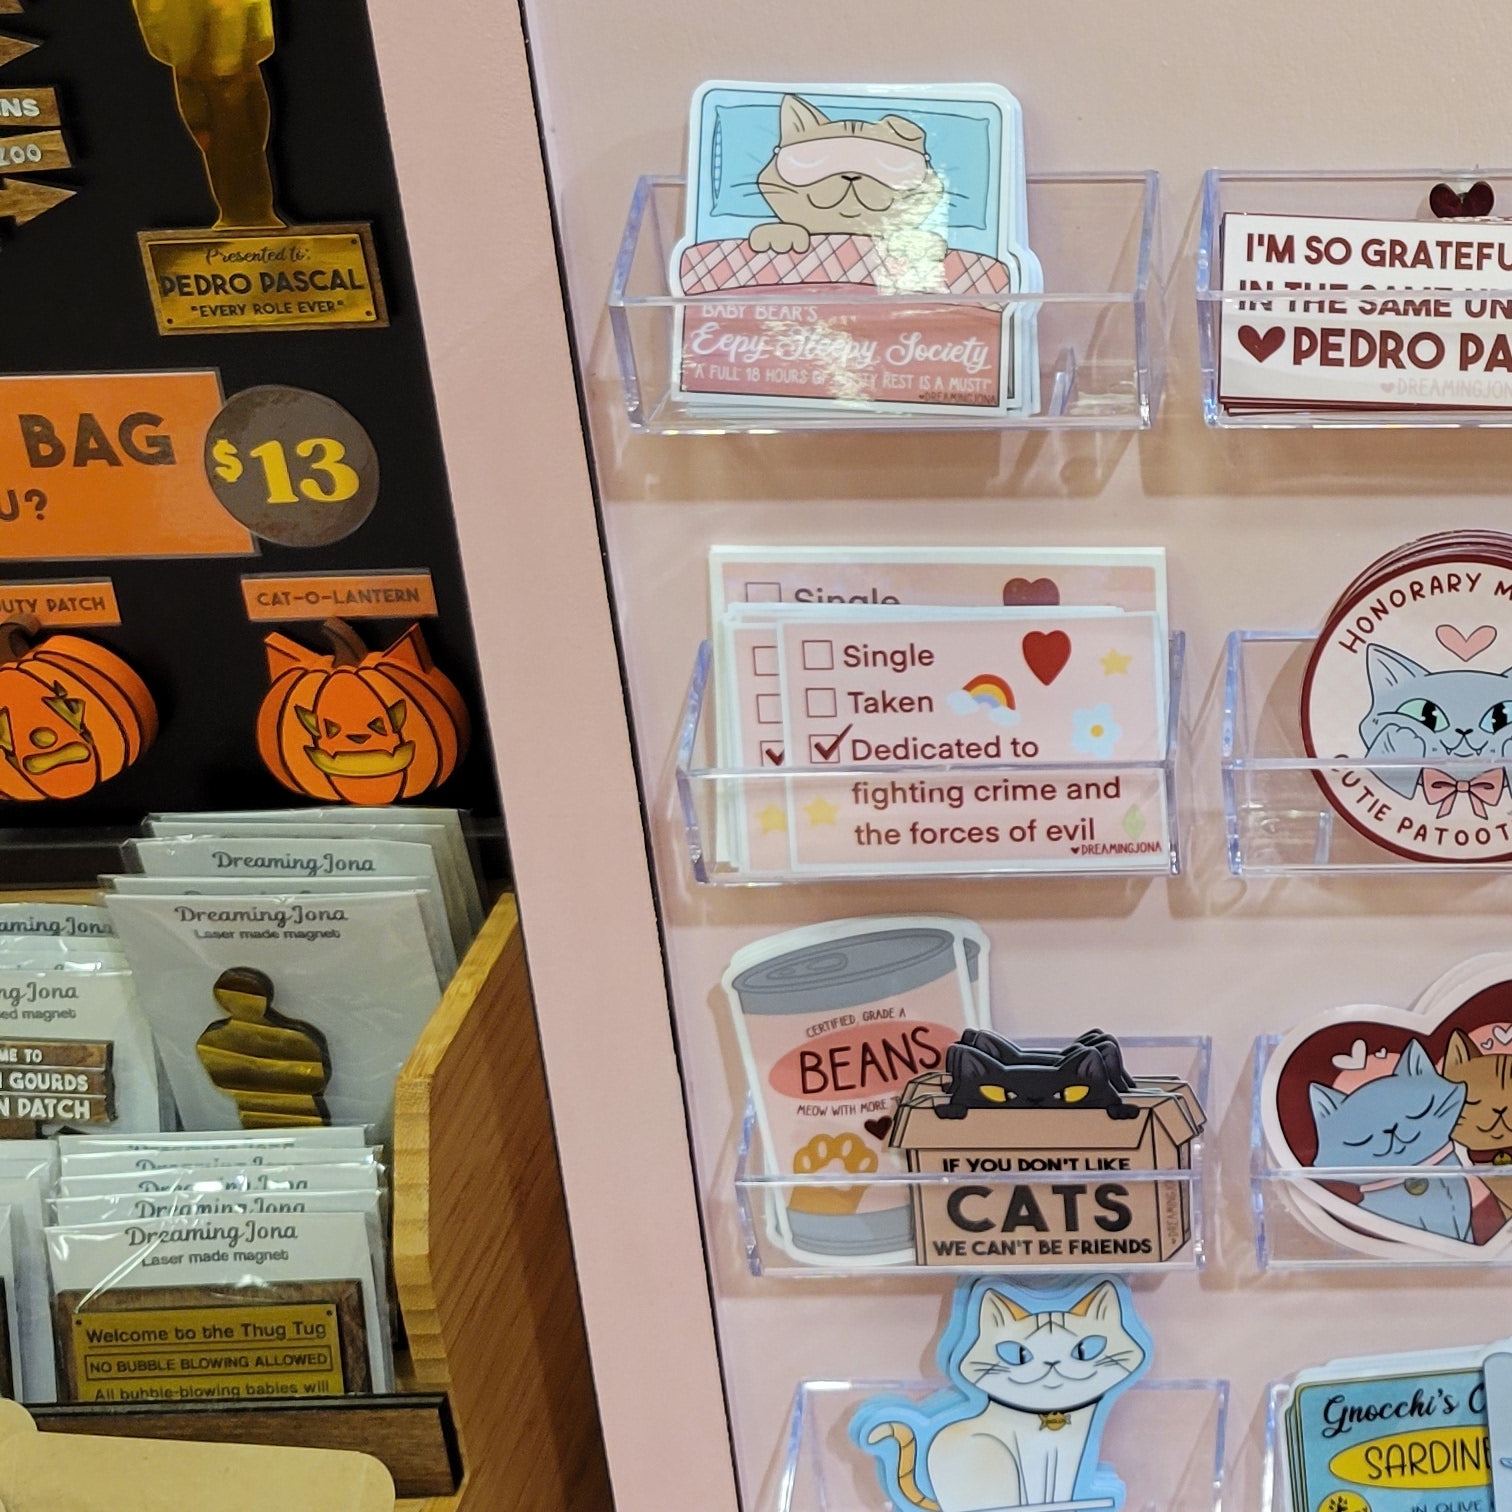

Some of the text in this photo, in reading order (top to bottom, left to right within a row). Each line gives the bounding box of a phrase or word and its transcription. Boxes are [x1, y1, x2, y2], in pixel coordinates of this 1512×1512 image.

[206, 246, 285, 266] Presented
[1245, 232, 1295, 264] I'M
[1304, 236, 1352, 266] SO
[159, 268, 366, 298] PEDRO PASCAL
[254, 301, 293, 315] ROLE
[1238, 280, 1274, 312] IN
[1284, 281, 1348, 314] THE
[1358, 284, 1453, 318] SAME
[702, 303, 818, 322] BABY BEAR'S
[690, 322, 992, 374] Eepy Society
[1292, 326, 1446, 371] PEDRO
[709, 365, 741, 381] FULL
[765, 368, 808, 385] HOURS
[883, 372, 914, 389] REST
[18, 412, 177, 469] BAG
[211, 437, 360, 503] $13
[46, 596, 106, 612] PATCH
[256, 589, 421, 606] CAT-O-LANTERN
[1338, 572, 1482, 655] HONORARY
[842, 643, 935, 672] Single
[847, 690, 934, 715] Taken
[851, 735, 1039, 762] Dedicated to
[851, 776, 1121, 810] fighting crime and
[854, 817, 1096, 846] the forces of evil
[1080, 841, 1163, 856] DREAMINGJONA
[212, 851, 377, 876] Dreaming Jona
[174, 904, 349, 929] Dreaming Jona
[239, 928, 280, 939] made
[283, 928, 341, 942] magnet
[26, 981, 79, 1003] Jona
[22, 1008, 77, 1022] magnet
[806, 1007, 895, 1038] CERTIFIED GRADE
[24, 1048, 43, 1064] TO
[799, 1025, 944, 1094] BEANS
[9, 1071, 89, 1093] GOURDS
[18, 1097, 91, 1121] PATCH
[797, 1104, 828, 1117] MEOW
[831, 1105, 857, 1117] WITH
[860, 1098, 889, 1114] MORE
[942, 1157, 1131, 1173] IF YOU DON'T LIKE
[946, 1183, 1133, 1234] CATS
[125, 1220, 298, 1248] Dreaming Jona
[189, 1250, 230, 1264] made
[233, 1249, 289, 1265] magnet
[932, 1238, 1153, 1257] WE CAN'T BE FRIENDS
[86, 1320, 328, 1345] Welcome to the Thug Tug
[89, 1352, 328, 1375] NO BUBBLE BLOWING ALLOWED
[303, 1379, 330, 1394] will
[1321, 1388, 1460, 1439] Gnocchi's
